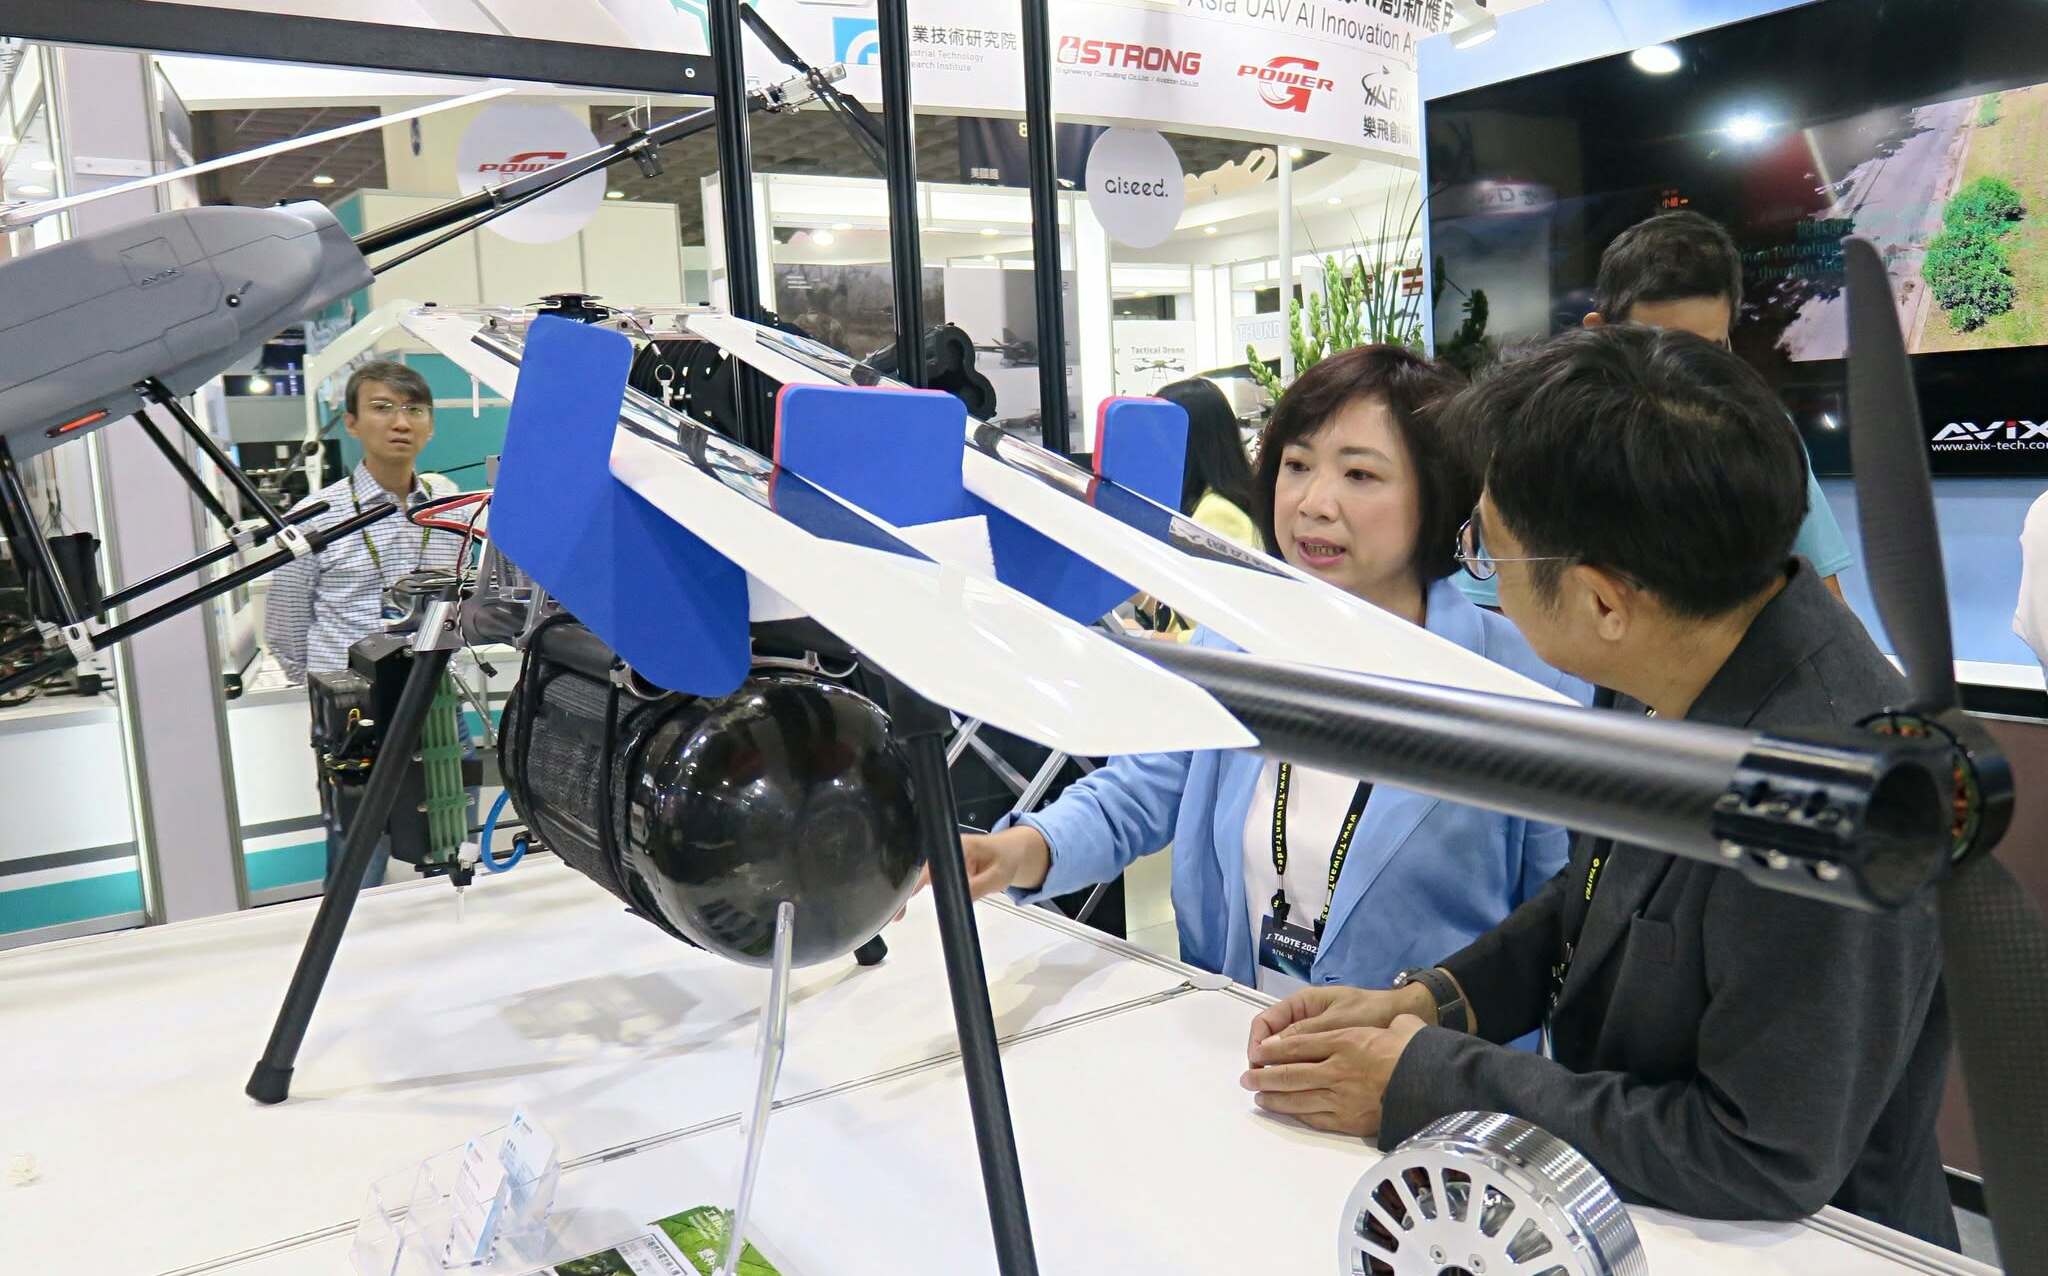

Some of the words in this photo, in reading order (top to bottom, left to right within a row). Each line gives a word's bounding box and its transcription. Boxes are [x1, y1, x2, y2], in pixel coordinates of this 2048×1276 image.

[1246, 0, 1292, 22] UAV
[1296, 2, 1315, 29] AI
[1321, 7, 1399, 51] Innovation
[912, 25, 1017, 51] 業技術研究院
[936, 62, 972, 71] Institute
[938, 51, 985, 63] Technology
[1080, 40, 1202, 76] STRONG
[1237, 64, 1335, 92] POWER
[478, 163, 553, 173] POW
[1105, 176, 1168, 197] aiseed.
[1273, 932, 1301, 948] TADTE
[1301, 942, 1319, 954] 202
